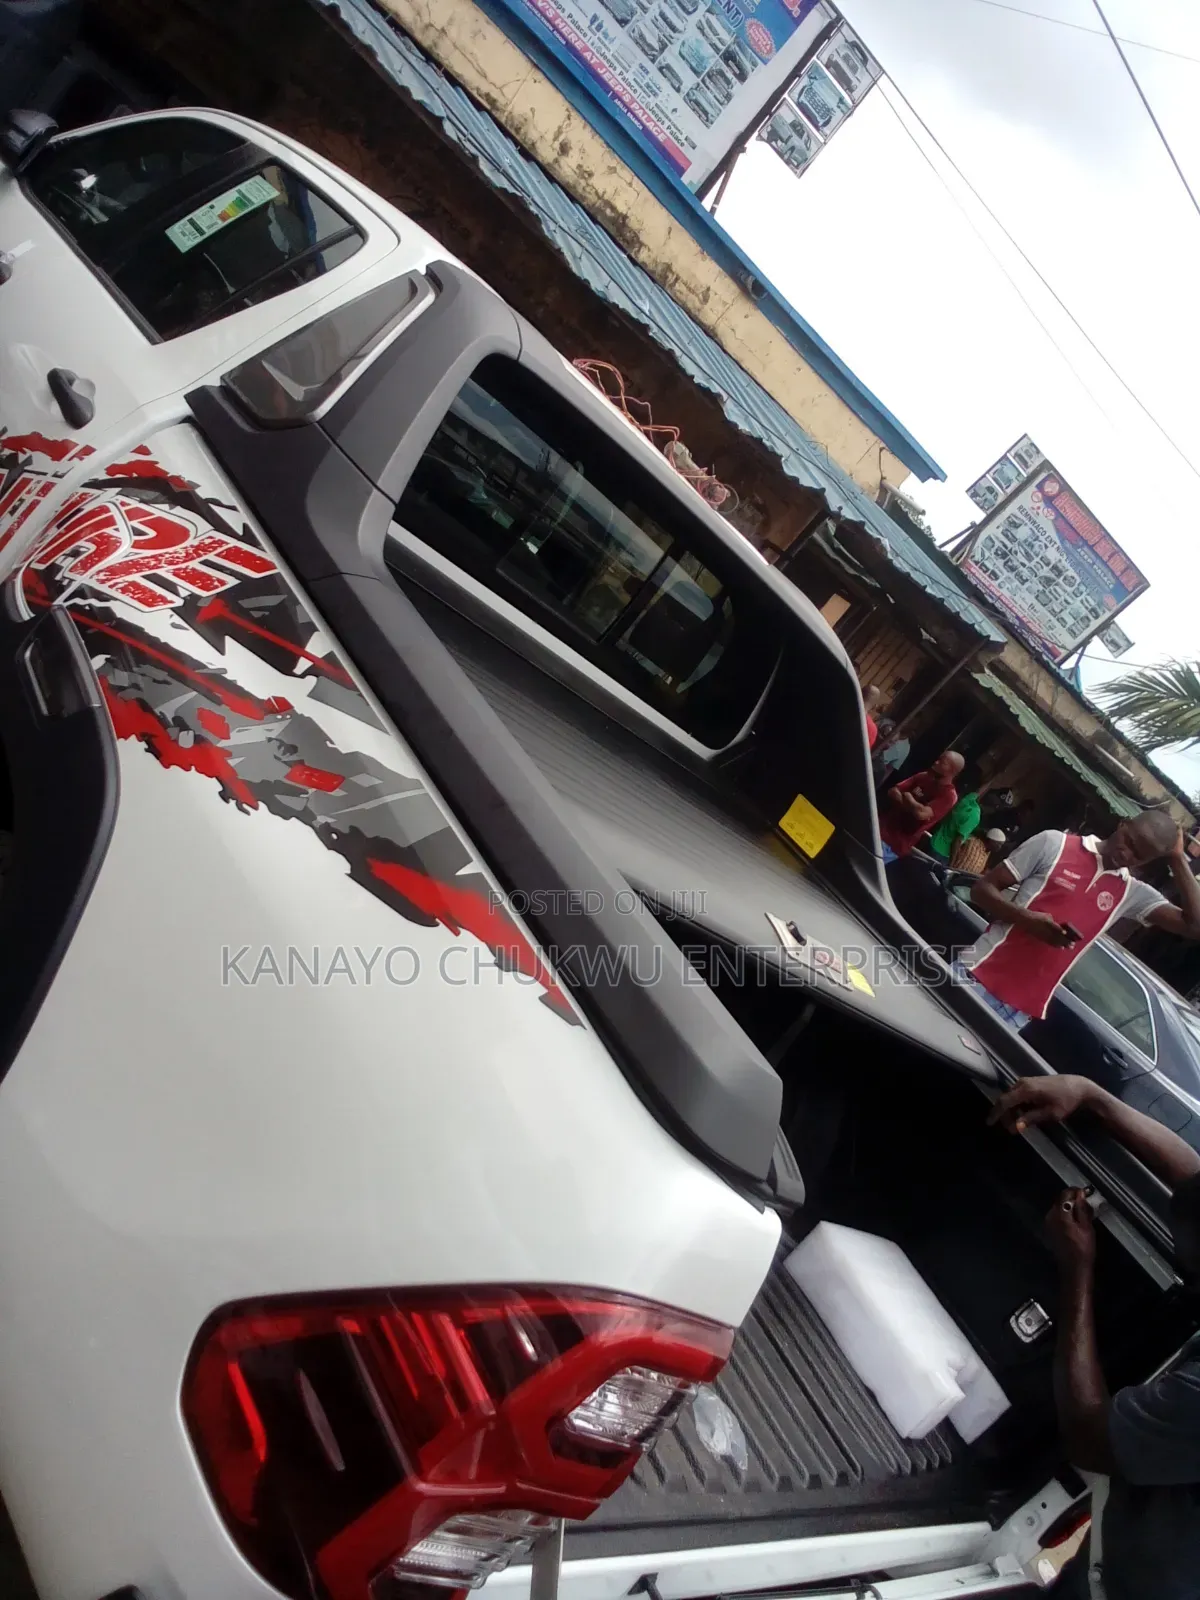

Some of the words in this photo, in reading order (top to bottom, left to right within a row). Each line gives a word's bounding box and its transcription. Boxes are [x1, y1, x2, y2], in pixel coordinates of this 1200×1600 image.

[554, 18, 585, 51] HERE
[583, 50, 600, 66] AT
[597, 66, 632, 103] JEEP'S
[630, 102, 668, 142] PALACE
[567, 13, 588, 38] Palace
[618, 70, 638, 95] Palace
[666, 124, 685, 148] Palace
[1091, 563, 1115, 589] PALACE
